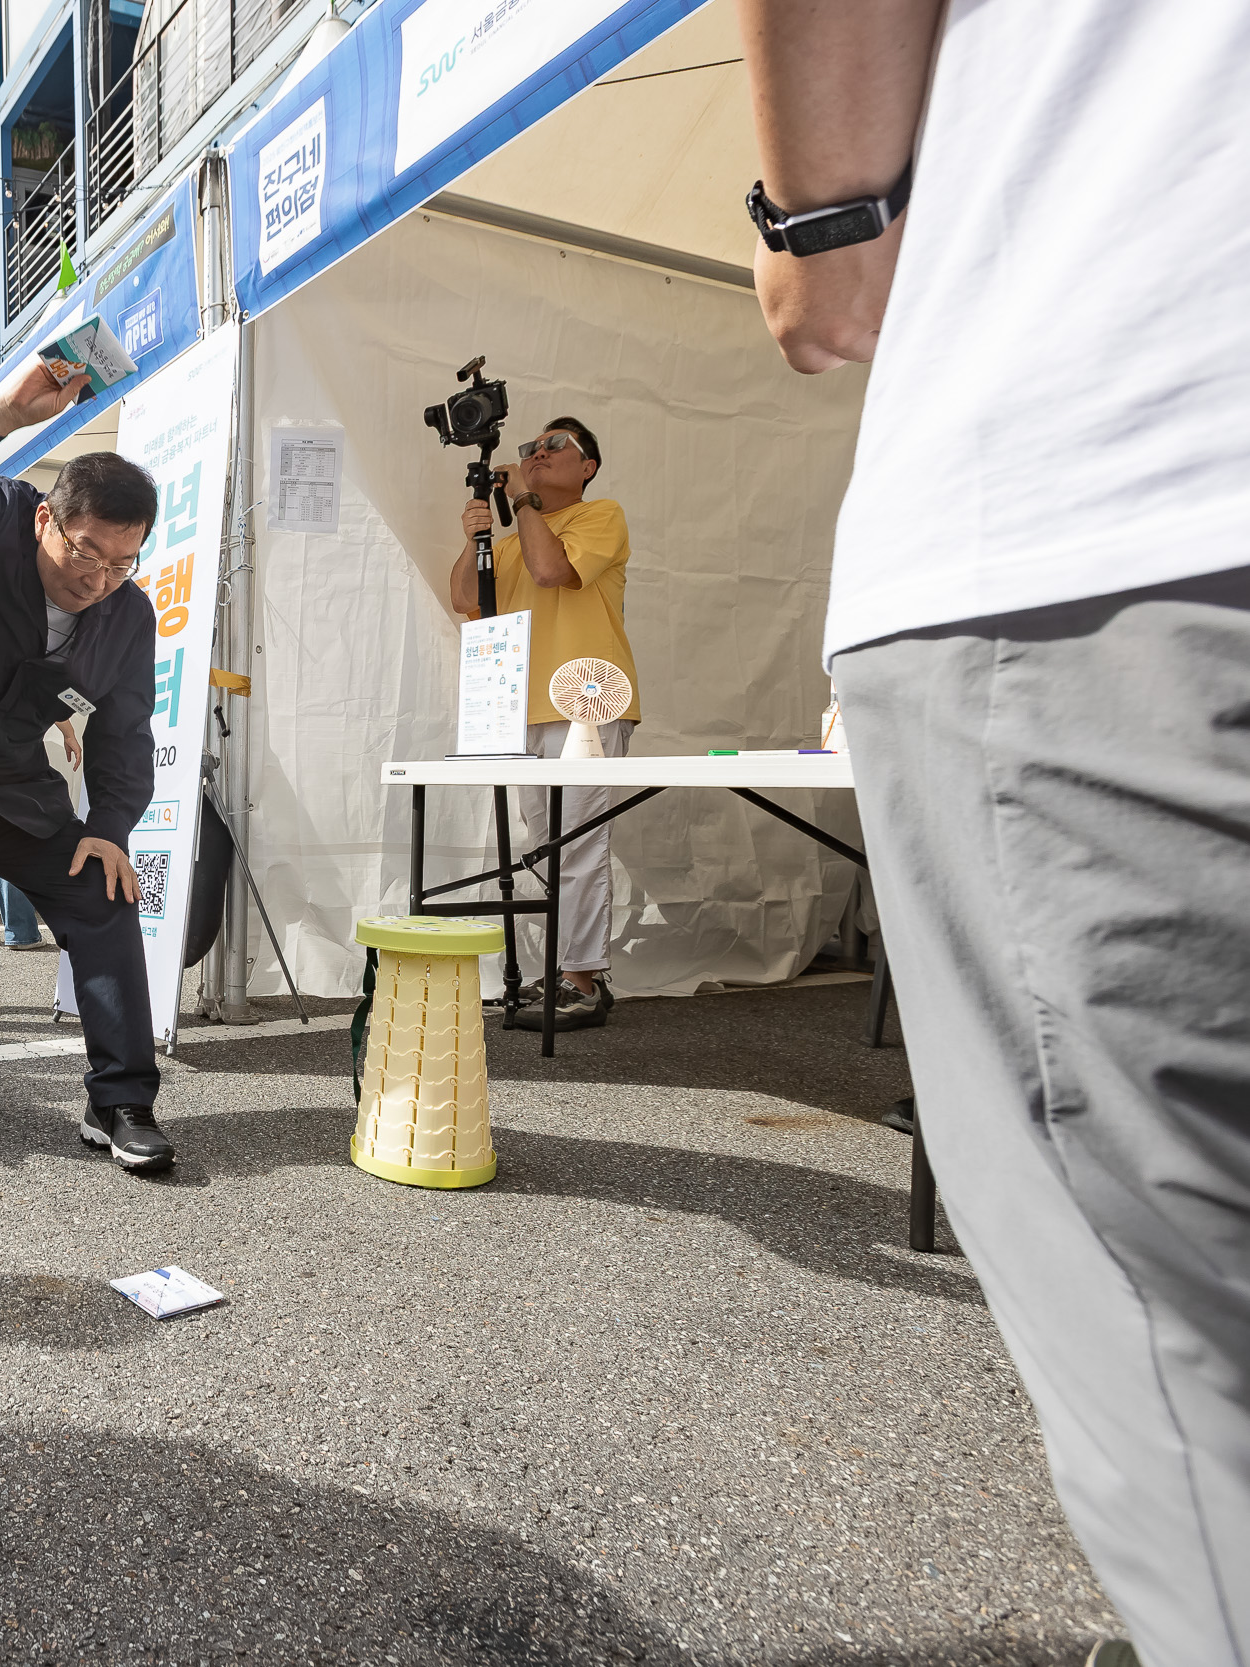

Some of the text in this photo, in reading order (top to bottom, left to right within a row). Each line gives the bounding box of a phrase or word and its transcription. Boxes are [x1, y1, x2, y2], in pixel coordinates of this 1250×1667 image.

[263, 132, 321, 203] 진구네
[266, 174, 319, 242] 편의점
[125, 313, 156, 356] OPEN
[161, 435, 192, 465] 금융복지
[193, 417, 218, 443] 파트너
[153, 648, 185, 728] 터
[154, 746, 177, 768] 120
[139, 809, 156, 824] 센터
[141, 926, 158, 938] 타그램
